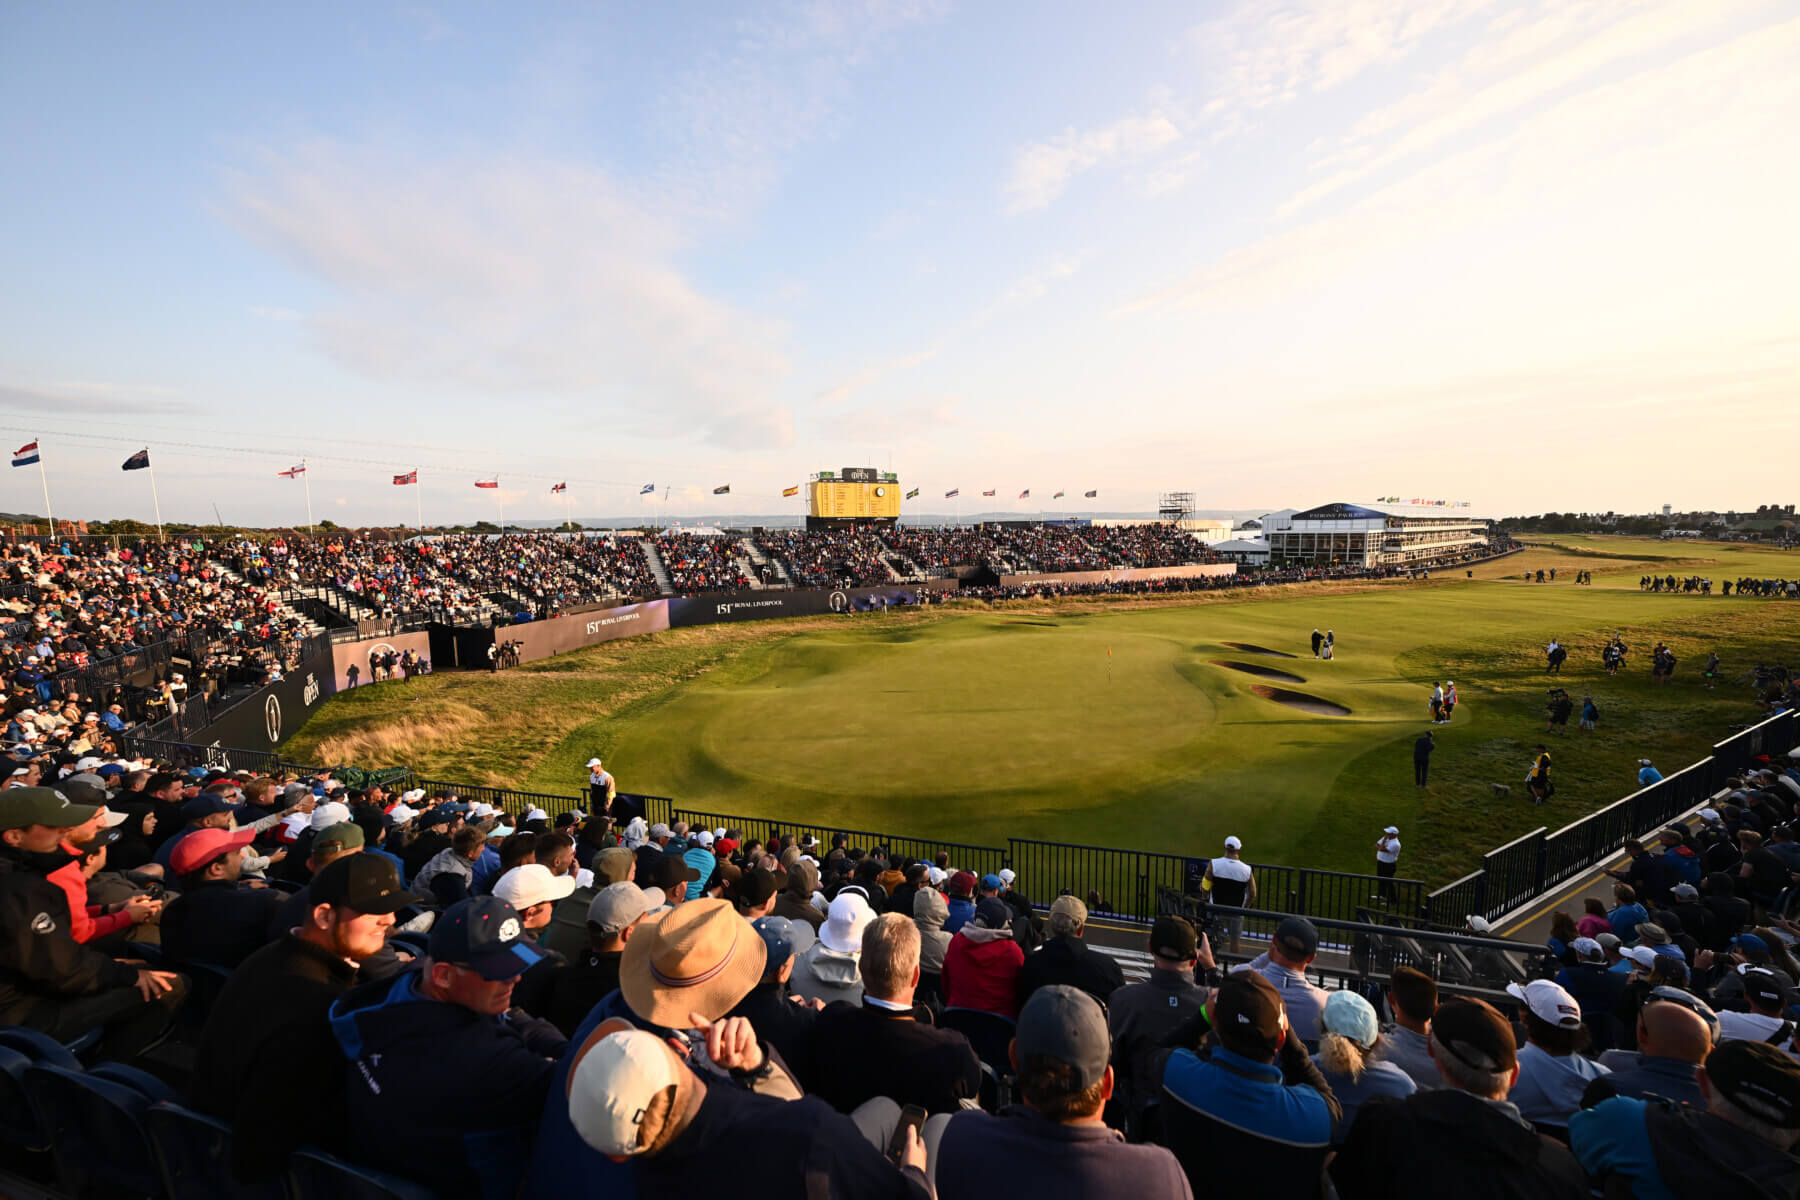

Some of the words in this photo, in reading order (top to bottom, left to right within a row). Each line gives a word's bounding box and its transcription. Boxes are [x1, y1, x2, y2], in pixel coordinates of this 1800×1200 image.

[851, 472, 869, 480] OPEN
[753, 599, 783, 607] LIVERPOOL
[304, 679, 320, 706] OPEN
